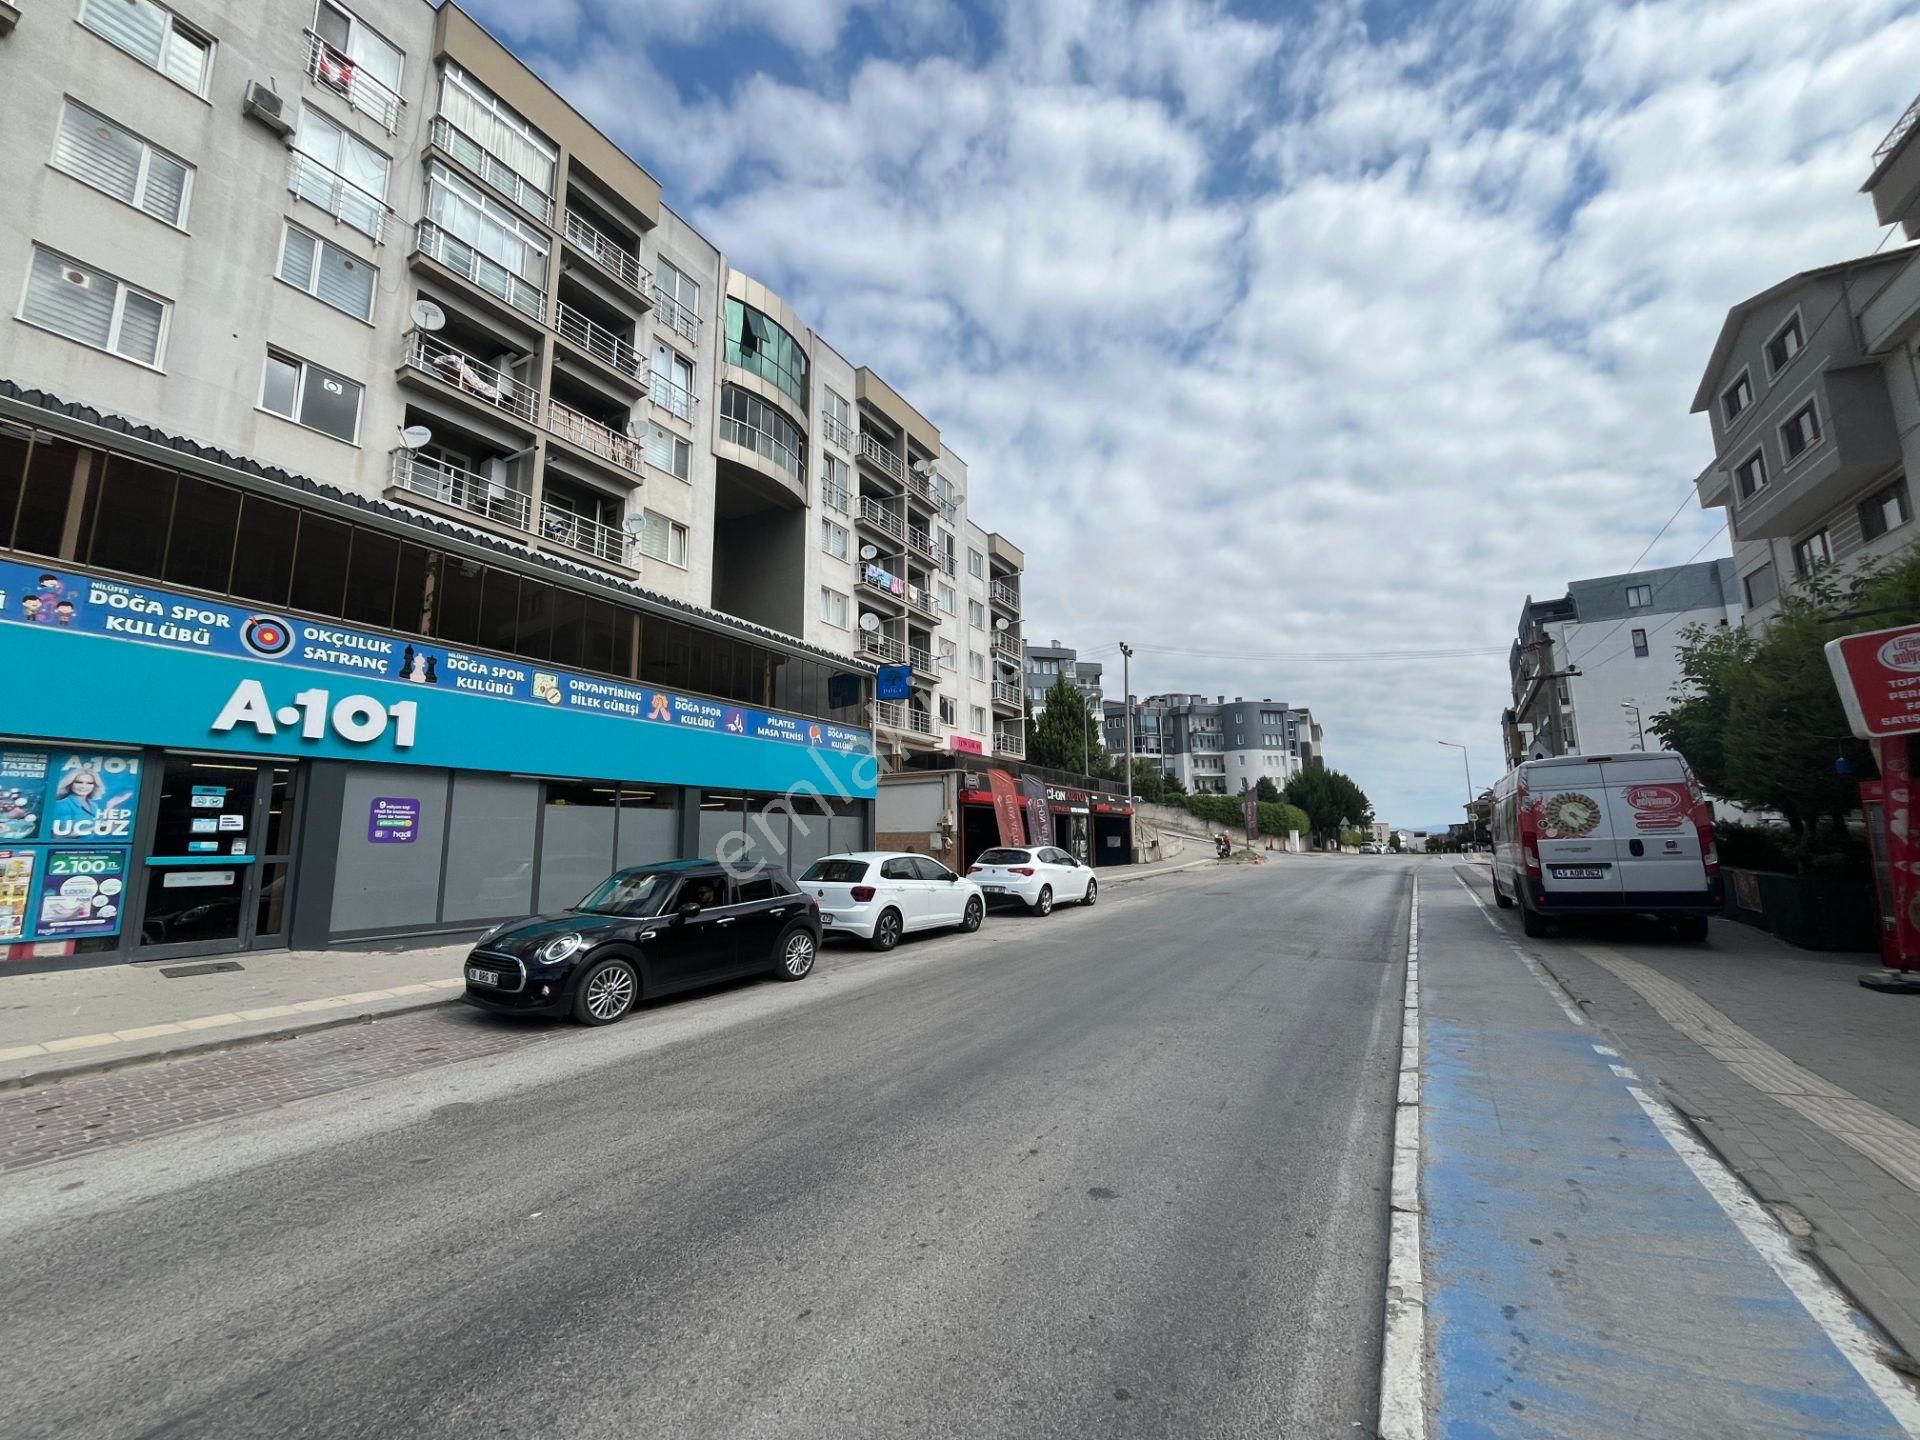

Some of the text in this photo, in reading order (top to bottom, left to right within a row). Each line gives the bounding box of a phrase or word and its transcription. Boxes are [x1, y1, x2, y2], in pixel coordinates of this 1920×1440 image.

[88, 589, 232, 629] DOĞA SPOR
[105, 615, 211, 646] KULÜBÜ
[303, 627, 393, 654] OKÇULUK
[303, 646, 388, 674] SATRANÇ
[447, 657, 525, 682] DOĞA SPOR
[456, 675, 514, 696] KULÜBÜ
[569, 679, 642, 702] ORYANTİRİNG
[570, 693, 640, 717] BİLEK GÜREŞİ
[675, 701, 722, 718] DOĞA SPOR
[681, 714, 715, 728] KULÜBÜ
[767, 716, 796, 730] PİLATES
[757, 727, 804, 742] MASA TENİSİ
[95, 808, 131, 820] HEP
[379, 801, 387, 809] 9
[52, 819, 129, 836] UCUZ
[51, 860, 105, 874] 2.100
